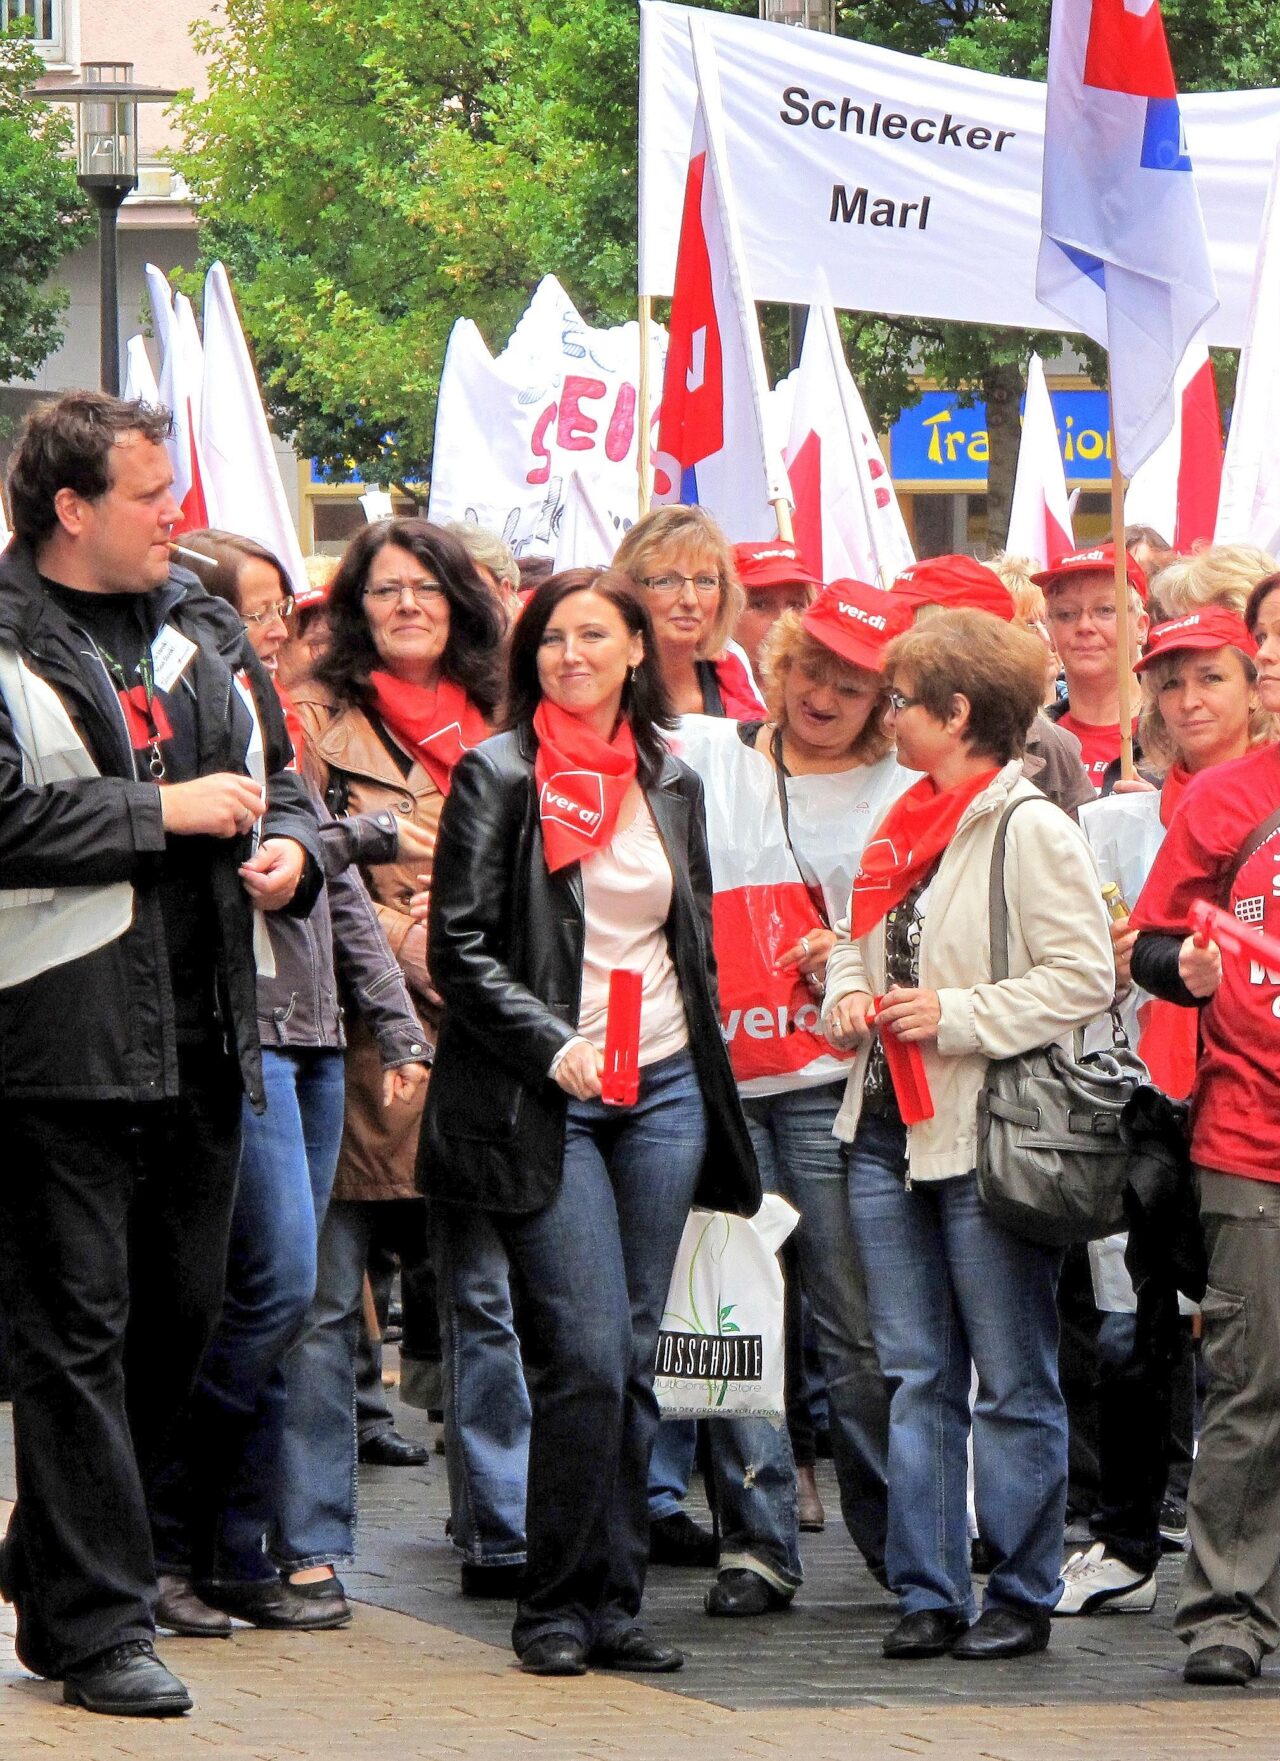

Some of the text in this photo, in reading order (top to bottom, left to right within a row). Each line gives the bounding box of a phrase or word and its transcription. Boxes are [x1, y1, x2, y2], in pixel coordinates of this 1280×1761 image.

[780, 86, 1016, 152] Schlecker
[829, 184, 931, 230] Marl
[838, 601, 887, 632] ver.di
